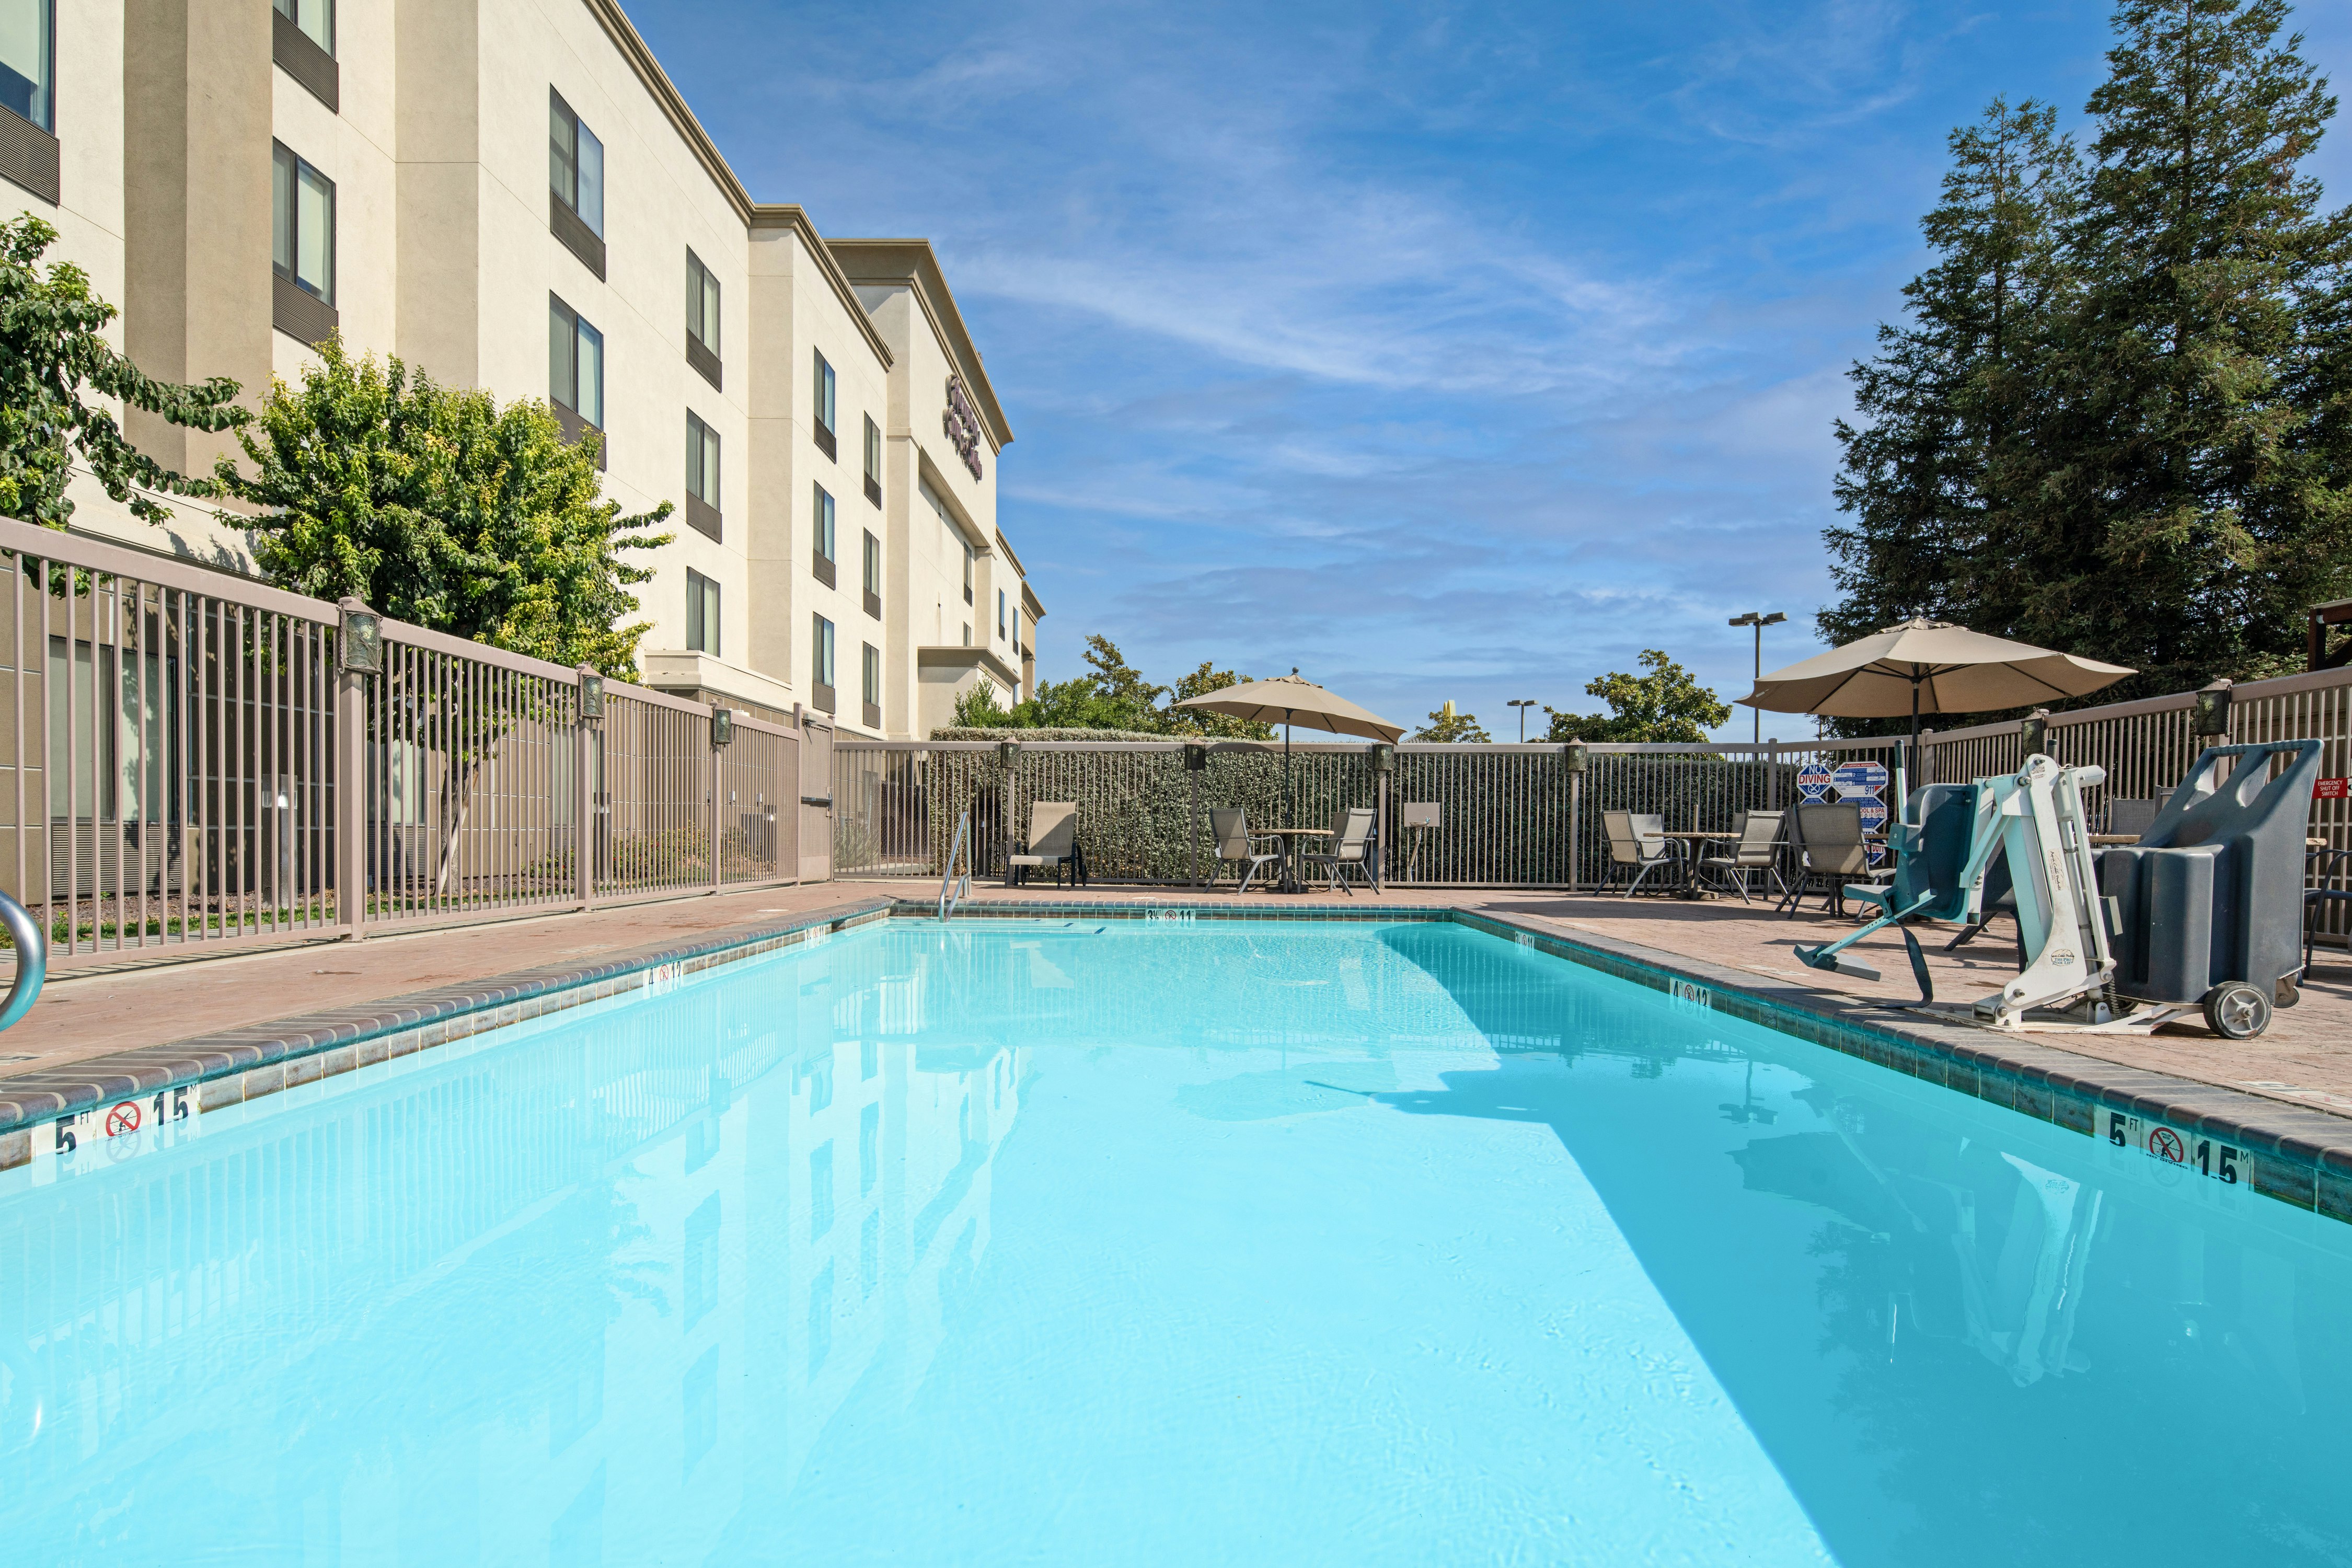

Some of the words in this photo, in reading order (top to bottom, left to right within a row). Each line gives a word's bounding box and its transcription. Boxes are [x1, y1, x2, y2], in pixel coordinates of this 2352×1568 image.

[1809, 765, 1822, 774] NO
[1798, 774, 1831, 784] DIVING
[1865, 786, 1874, 795] 911
[649, 967, 654, 985] 4
[1674, 981, 1679, 997] 4
[55, 1114, 77, 1155] 5
[80, 1110, 90, 1125] FT
[190, 1083, 197, 1093] M
[2109, 1112, 2126, 1147] 5
[2129, 1117, 2139, 1132] FT
[2240, 1150, 2249, 1165] M
[2160, 1158, 2188, 1170] DIVING
